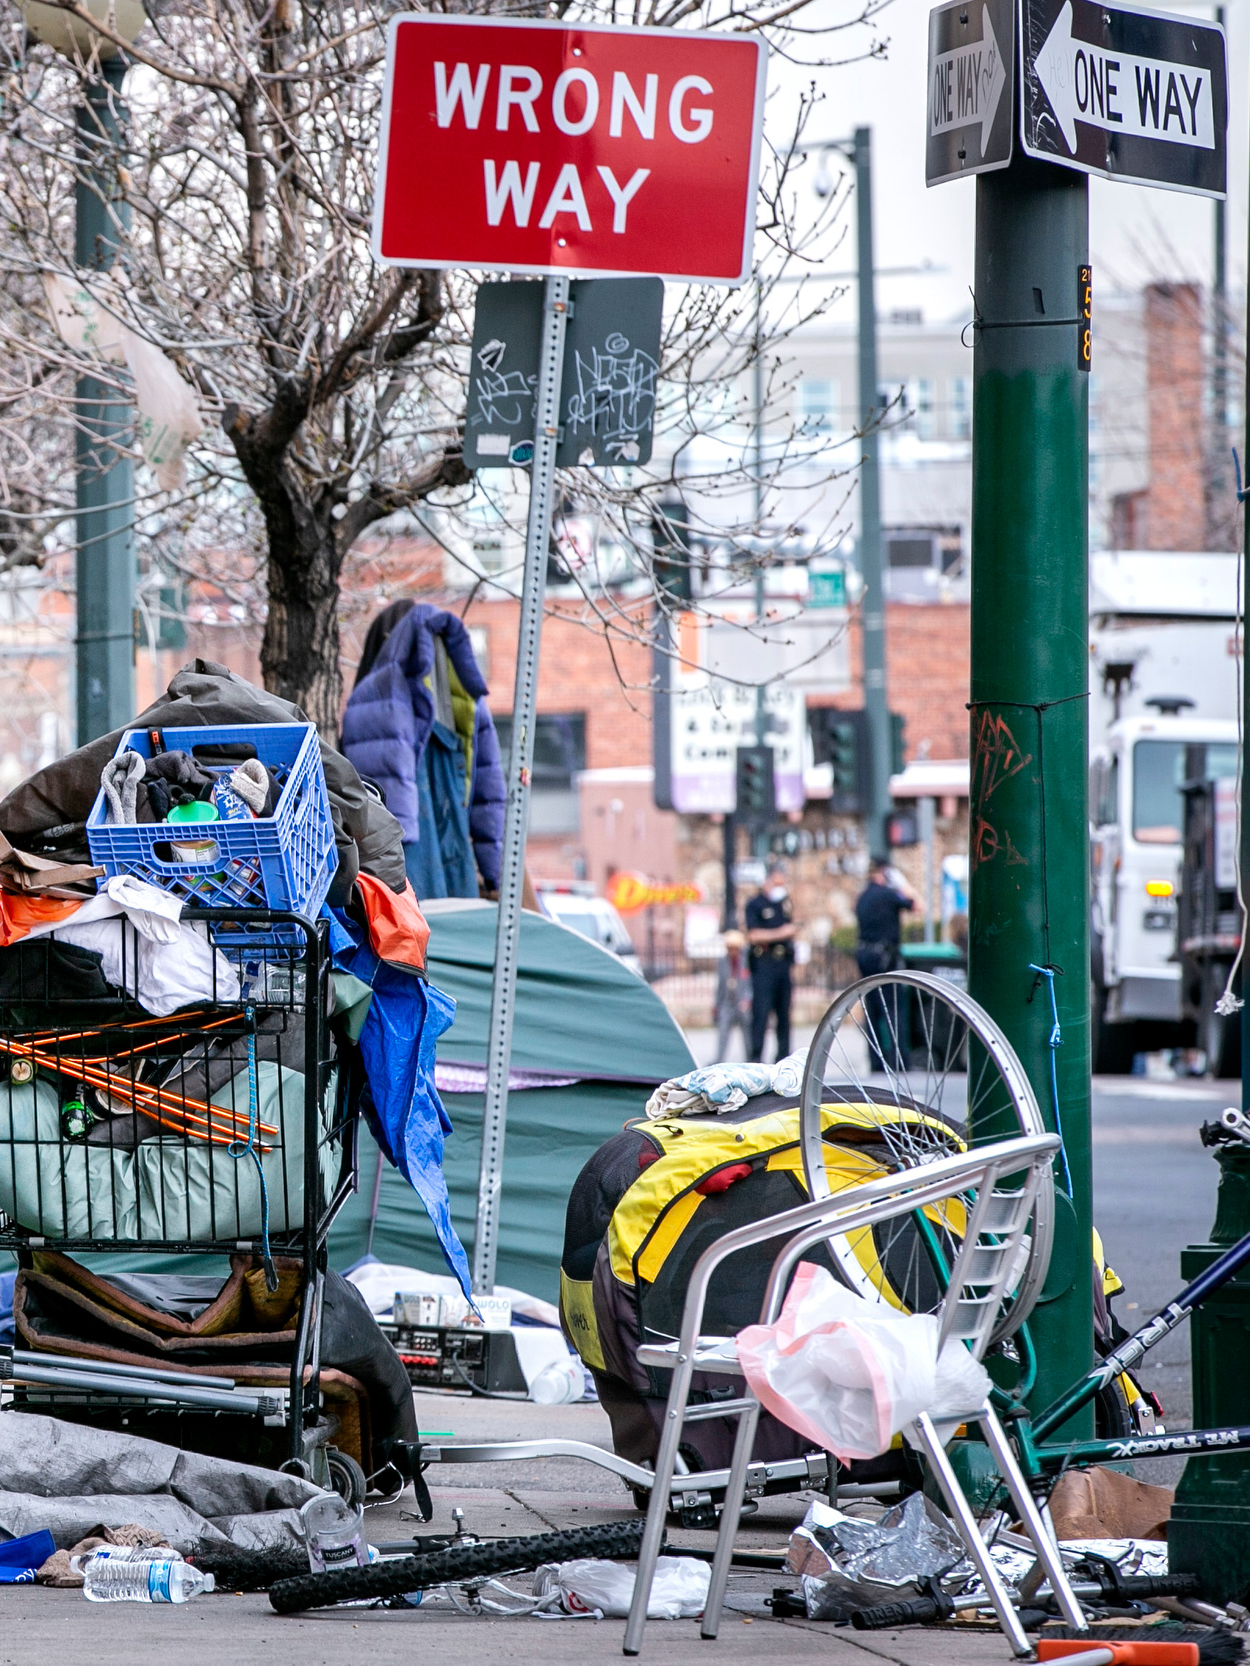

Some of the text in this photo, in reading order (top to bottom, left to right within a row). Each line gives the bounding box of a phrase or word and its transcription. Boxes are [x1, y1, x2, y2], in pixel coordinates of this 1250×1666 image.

[433, 61, 715, 144] WRONG
[934, 60, 954, 127] ONE
[957, 50, 982, 119] WAY
[1074, 48, 1124, 125] ONE
[1134, 64, 1203, 137] WAY
[483, 159, 651, 234] WAY
[478, 1299, 510, 1310] WOLO
[1087, 1302, 1193, 1391] TREK
[325, 1547, 354, 1558] TUSCANY
